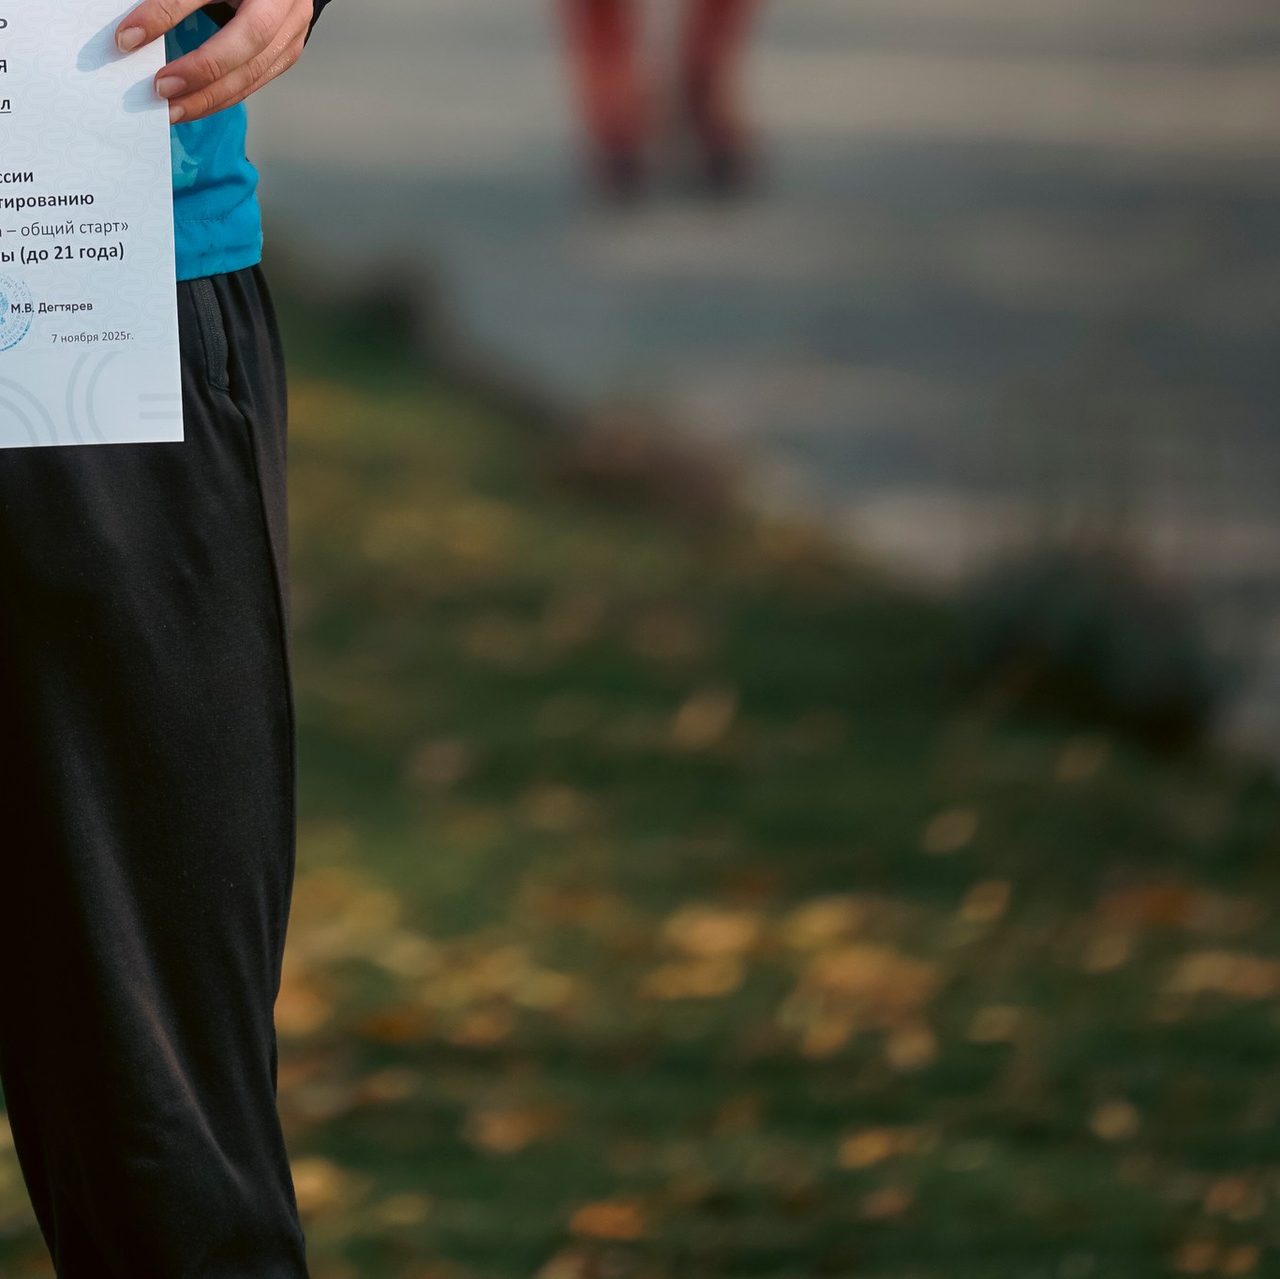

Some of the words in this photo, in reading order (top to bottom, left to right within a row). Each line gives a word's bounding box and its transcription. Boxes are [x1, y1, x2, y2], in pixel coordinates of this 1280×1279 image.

[20, 220, 75, 238] общий
[79, 222, 129, 237] старт»
[20, 245, 49, 265] (до
[53, 245, 74, 260] 21
[79, 241, 125, 262] года)
[10, 302, 35, 314] М.В.
[37, 302, 93, 315] Дегтярев
[51, 333, 58, 344] 7
[60, 331, 99, 344] ноября
[101, 330, 135, 342] 2025г.
